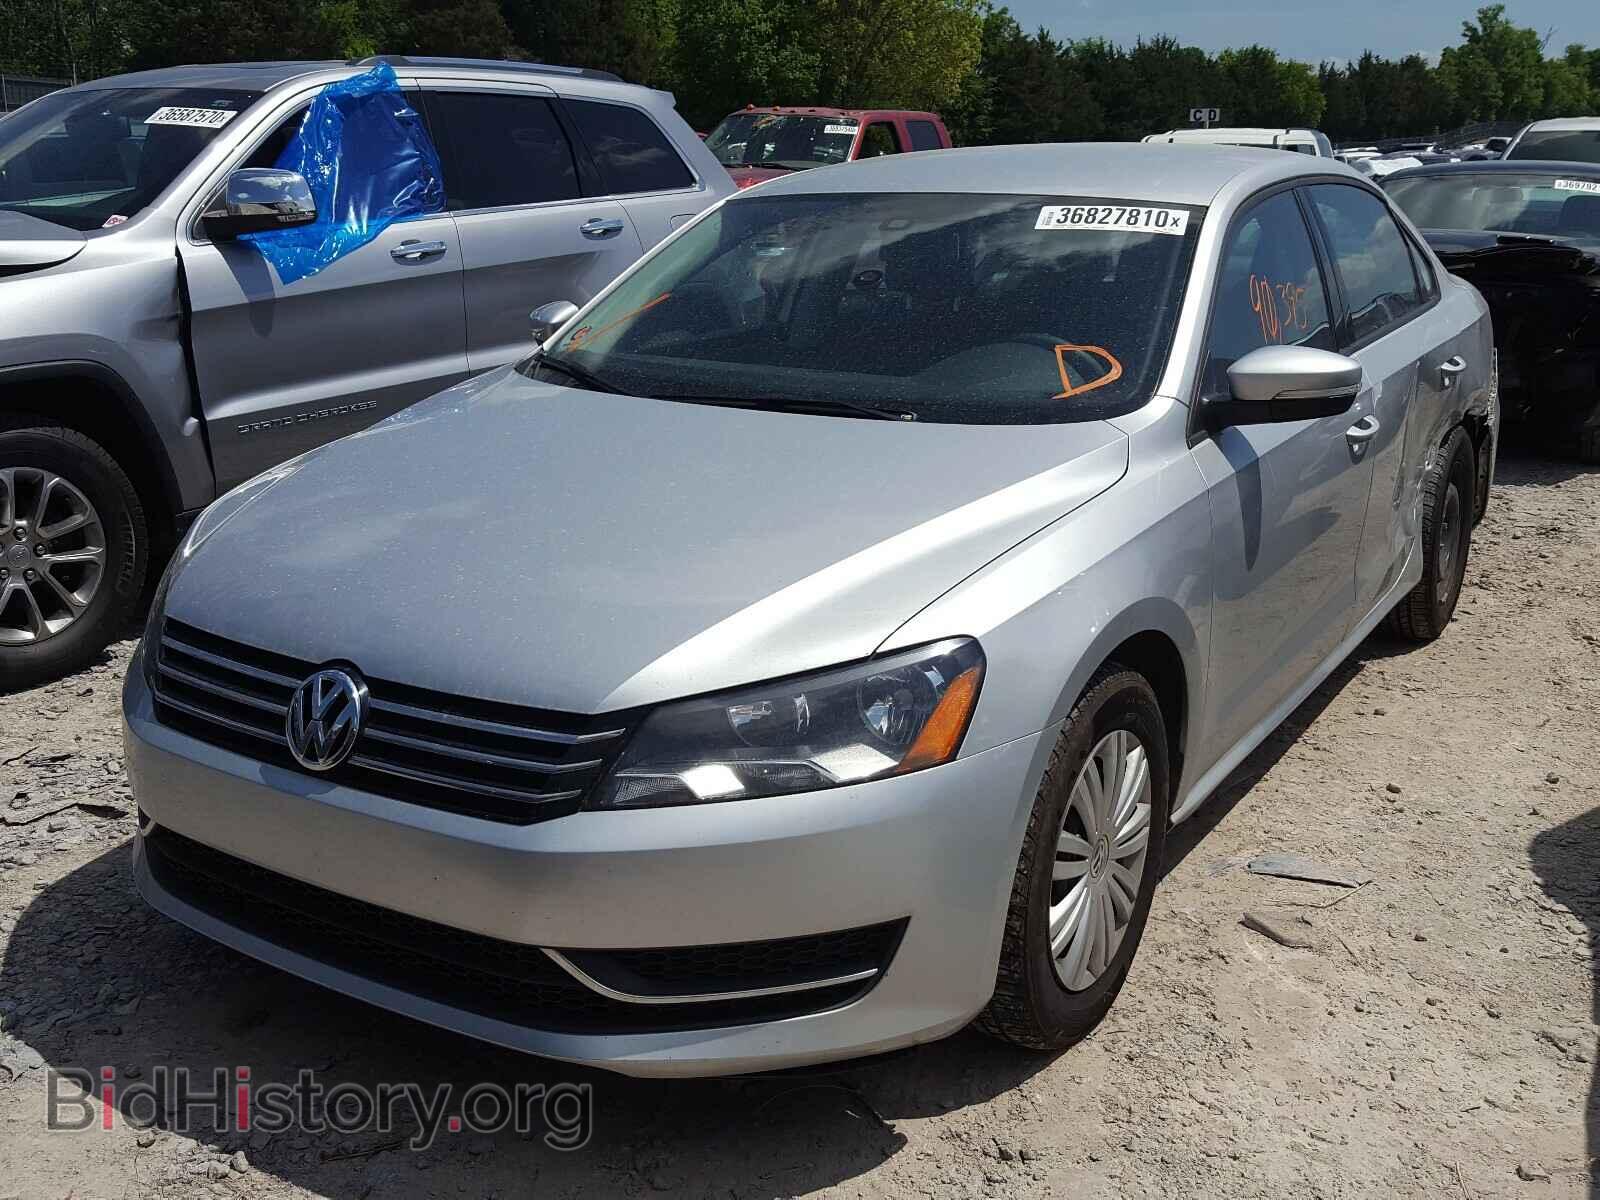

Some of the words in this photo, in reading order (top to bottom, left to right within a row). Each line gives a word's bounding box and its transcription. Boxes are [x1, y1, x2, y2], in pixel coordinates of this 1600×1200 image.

[1193, 110, 1203, 121] C
[1208, 110, 1217, 121] D
[1051, 344, 1123, 400] D
[297, 400, 378, 423] CHEROKEE
